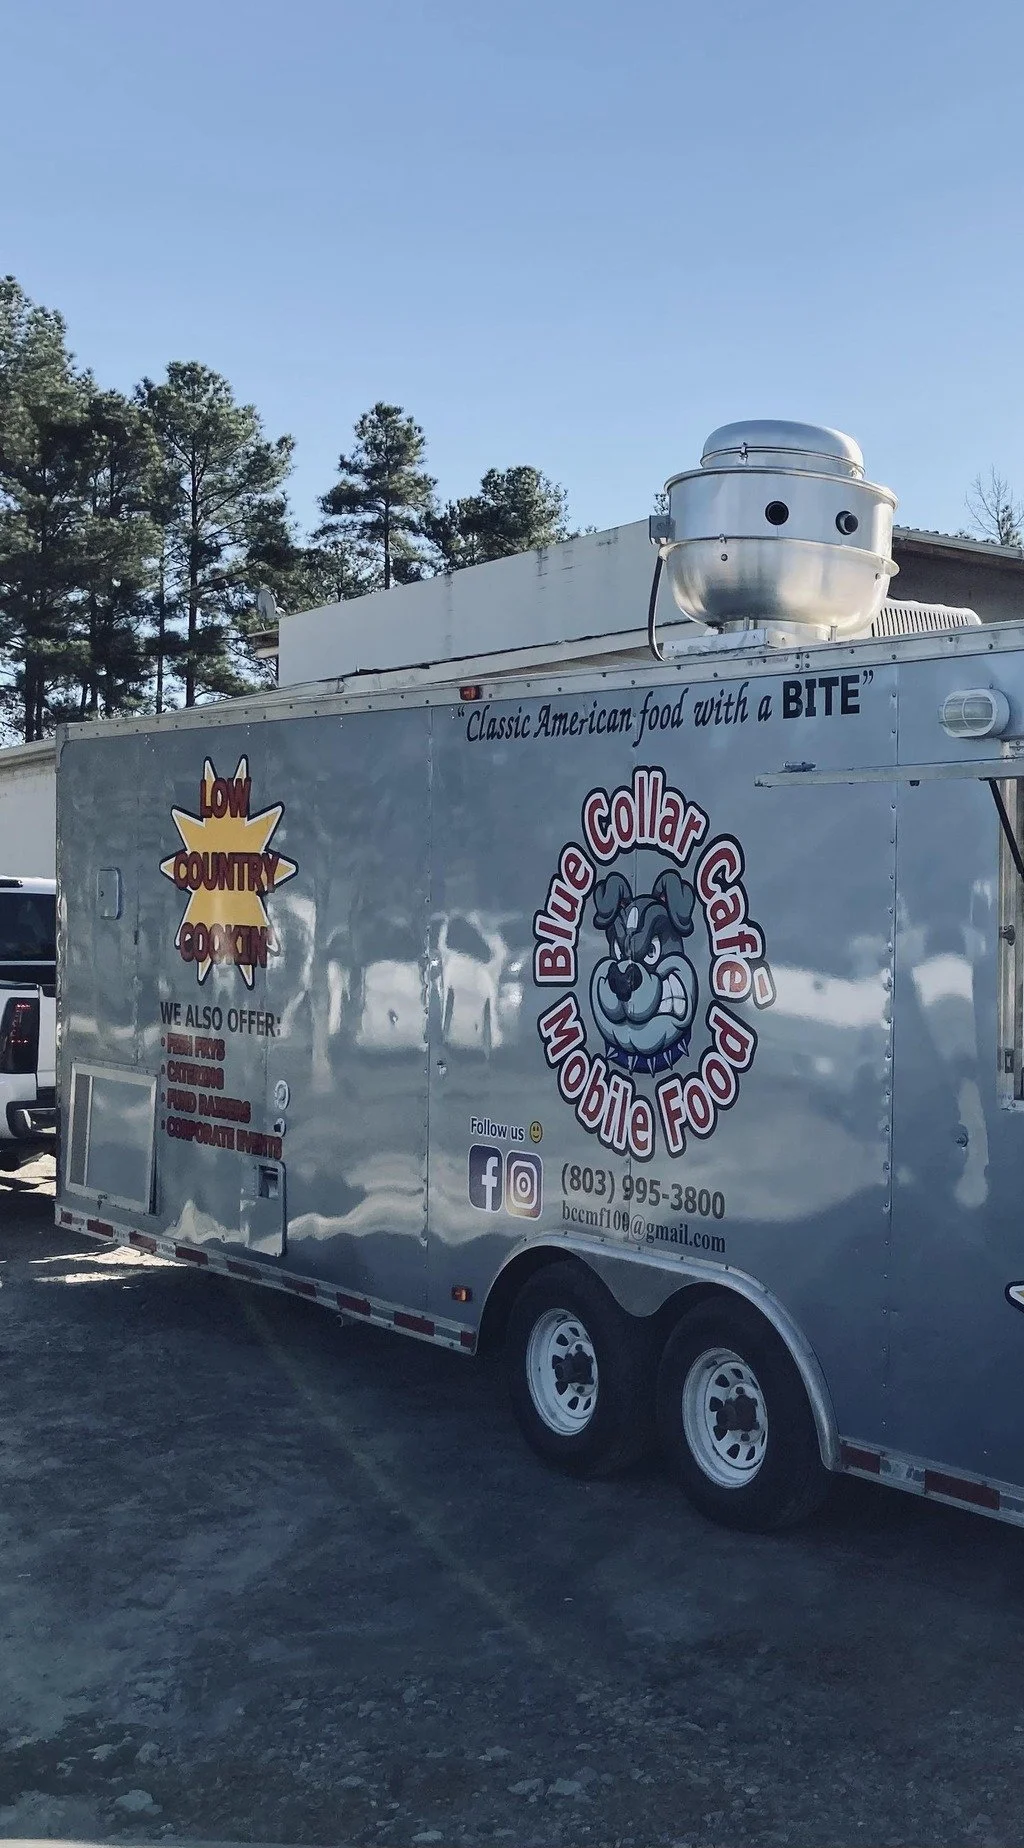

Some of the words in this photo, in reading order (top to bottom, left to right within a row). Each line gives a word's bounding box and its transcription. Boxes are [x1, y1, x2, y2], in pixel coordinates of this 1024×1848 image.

[533, 703, 633, 738] American
[632, 688, 689, 747] food
[693, 682, 749, 727] with
[757, 697, 772, 720] a
[200, 777, 252, 818] LOW
[173, 851, 279, 893] COUNTRY
[533, 842, 597, 987] Blue
[582, 765, 710, 867] Collar
[160, 1002, 181, 1026] WE
[186, 1005, 222, 1030] ALSO
[228, 1008, 281, 1037] OFFER:
[167, 1060, 224, 1090] CATERING
[538, 991, 656, 1162] Mobile
[655, 1000, 759, 1158] Food
[167, 1088, 197, 1113] FUND
[167, 1116, 235, 1150] CORPORATE
[470, 1115, 507, 1139] Follow
[510, 1126, 525, 1142] us
[561, 1162, 615, 1204] (803)
[622, 1175, 725, 1219] 995-3800
